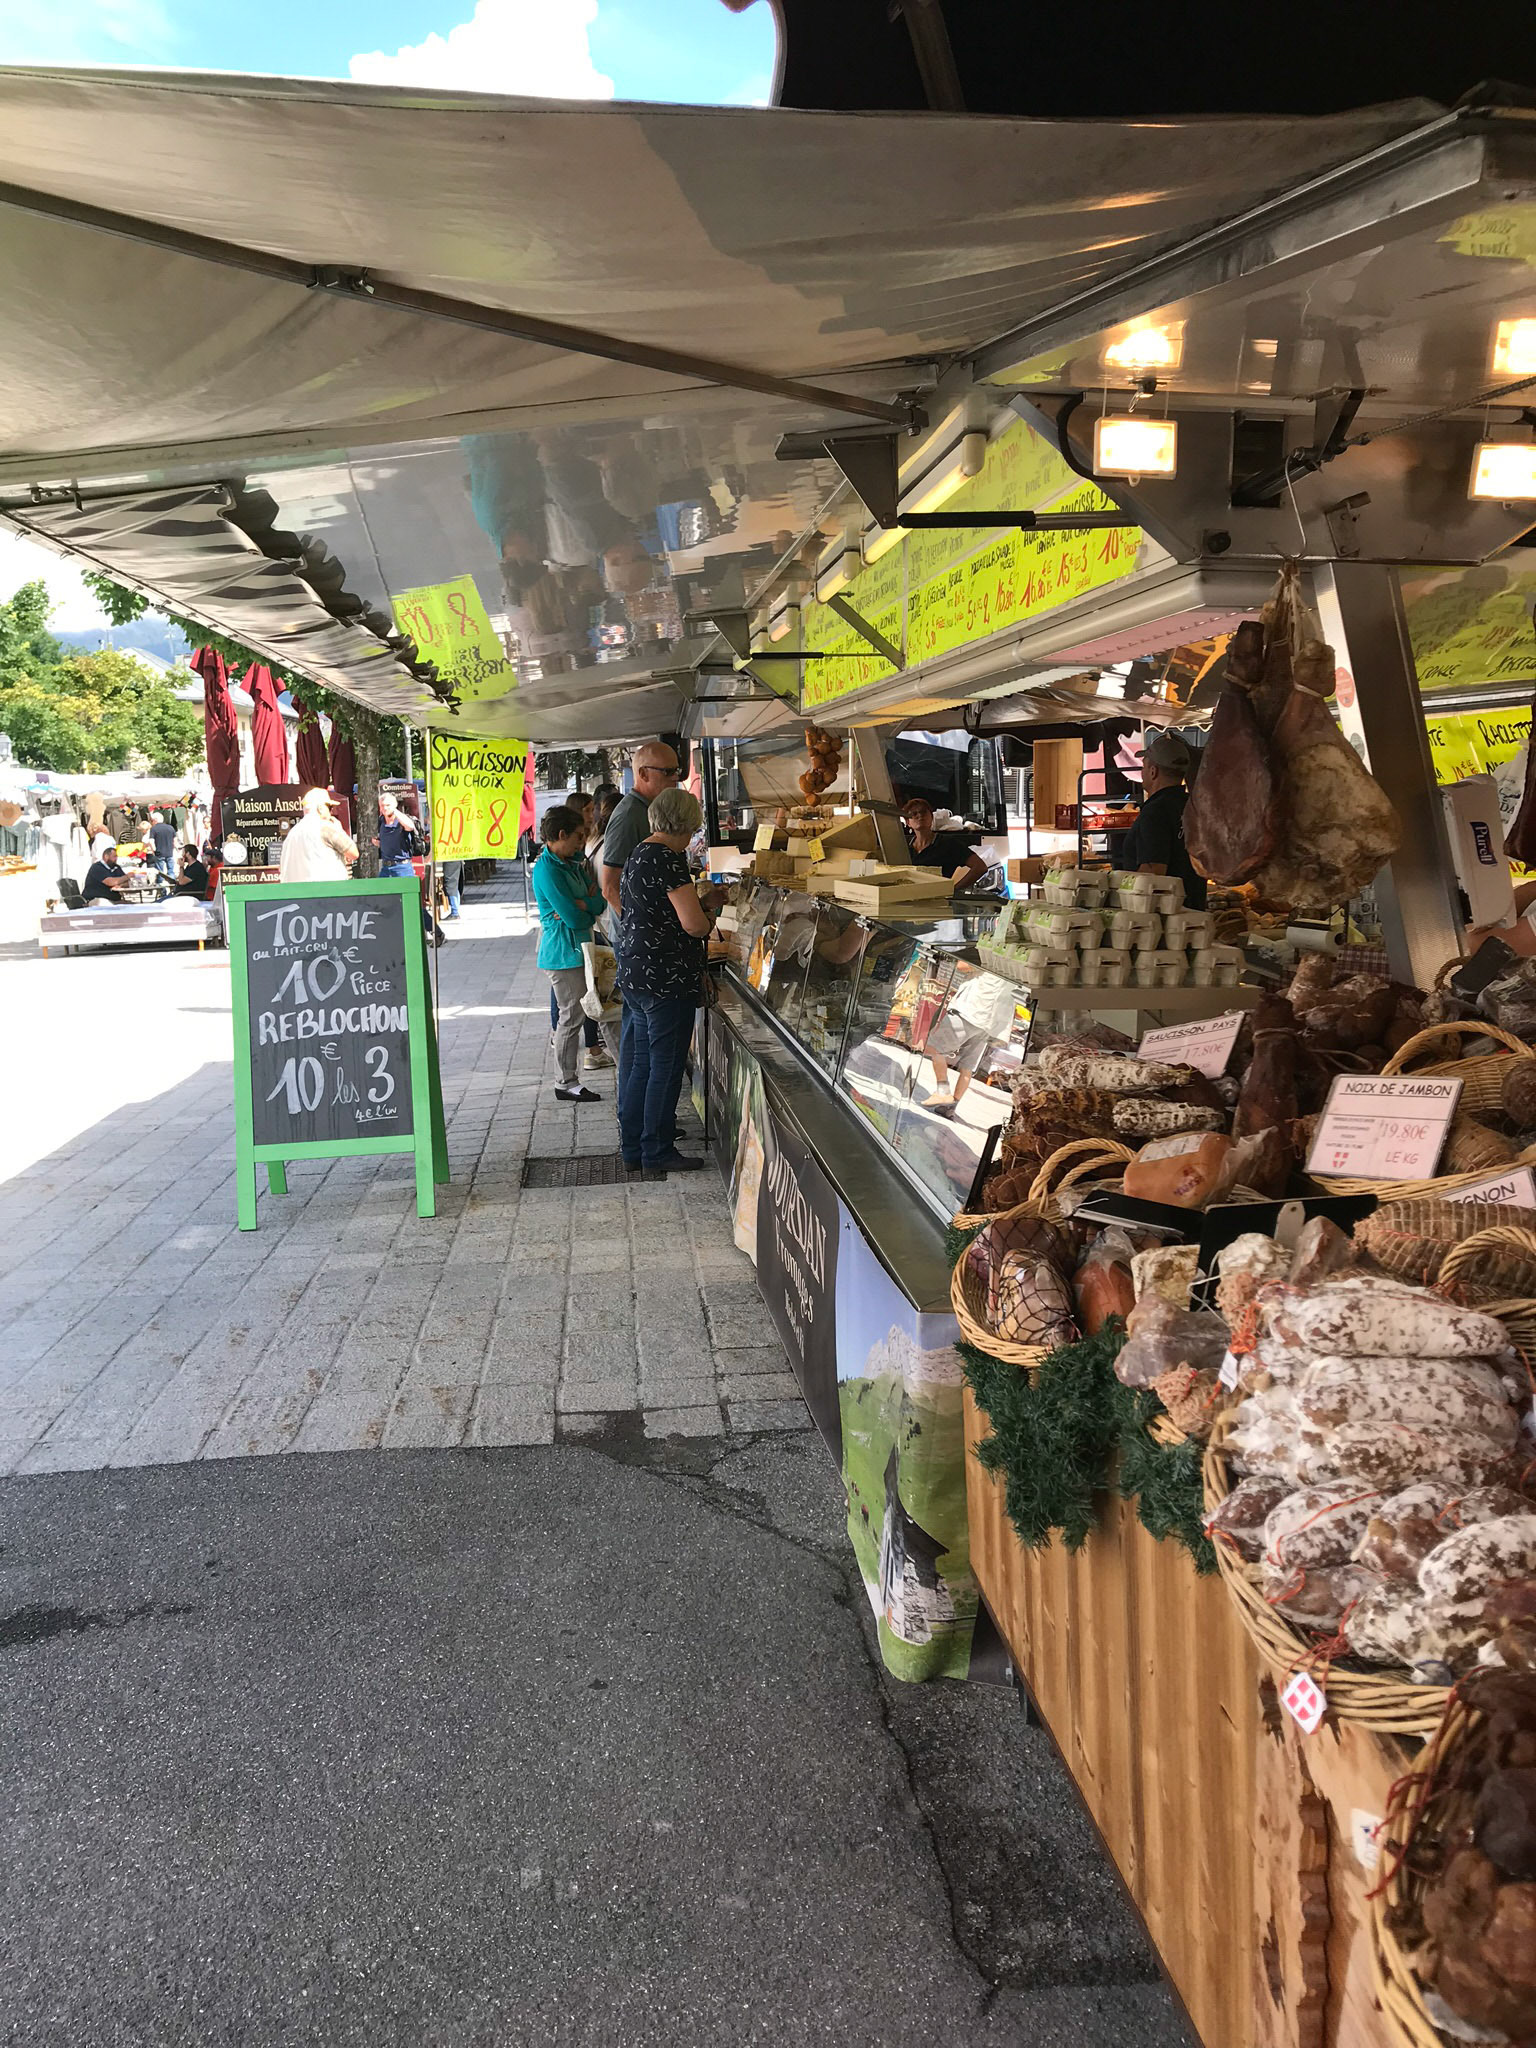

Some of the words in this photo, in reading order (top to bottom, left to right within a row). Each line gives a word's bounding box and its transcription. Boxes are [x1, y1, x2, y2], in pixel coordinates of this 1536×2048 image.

[1097, 528, 1119, 565] 10
[1056, 552, 1071, 589] 15
[1080, 542, 1088, 574] 3
[431, 733, 527, 774] SAUCISSON
[442, 773, 460, 788] AU
[463, 773, 505, 789] CHOIX
[234, 798, 273, 814] Maison
[435, 797, 464, 847] 20
[485, 798, 508, 847] 8
[1475, 825, 1493, 863] Purell
[222, 872, 258, 883] Maison
[256, 903, 384, 947] TOMME
[271, 955, 347, 1005] 10
[342, 946, 363, 964] €
[258, 1003, 409, 1046] REBLOCHON
[1147, 1025, 1206, 1041] SAUCISSON
[1211, 1018, 1238, 1030] PAYS
[1183, 1041, 1226, 1060] 17.80€
[265, 1056, 325, 1115] 10
[320, 1041, 342, 1061] €
[331, 1066, 361, 1106] les
[364, 1045, 395, 1103] 3
[1344, 1082, 1379, 1093] NOIX
[1379, 1083, 1397, 1094] DE
[1399, 1084, 1453, 1096] JAMBON
[1384, 1151, 1401, 1164] LE
[1402, 1152, 1420, 1165] KG
